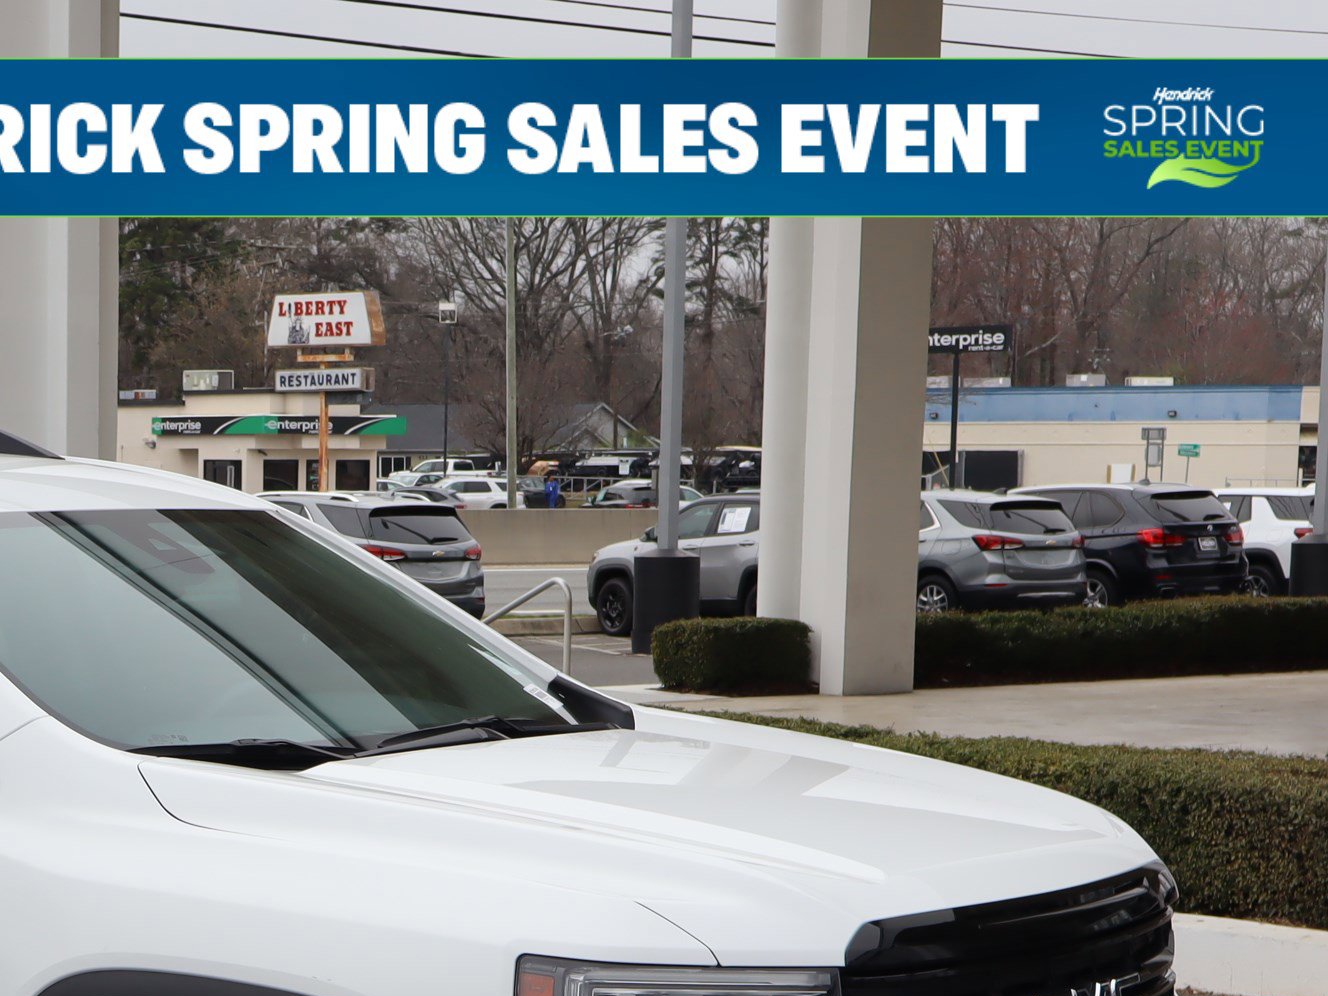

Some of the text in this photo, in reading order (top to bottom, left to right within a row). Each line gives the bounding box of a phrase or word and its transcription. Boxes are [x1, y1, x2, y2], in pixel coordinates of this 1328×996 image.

[278, 300, 347, 317] LIBERTY
[315, 321, 353, 337] EAST
[280, 373, 356, 388] RESTAURANT
[153, 419, 201, 432] enterprise
[266, 419, 333, 432] enterprie
